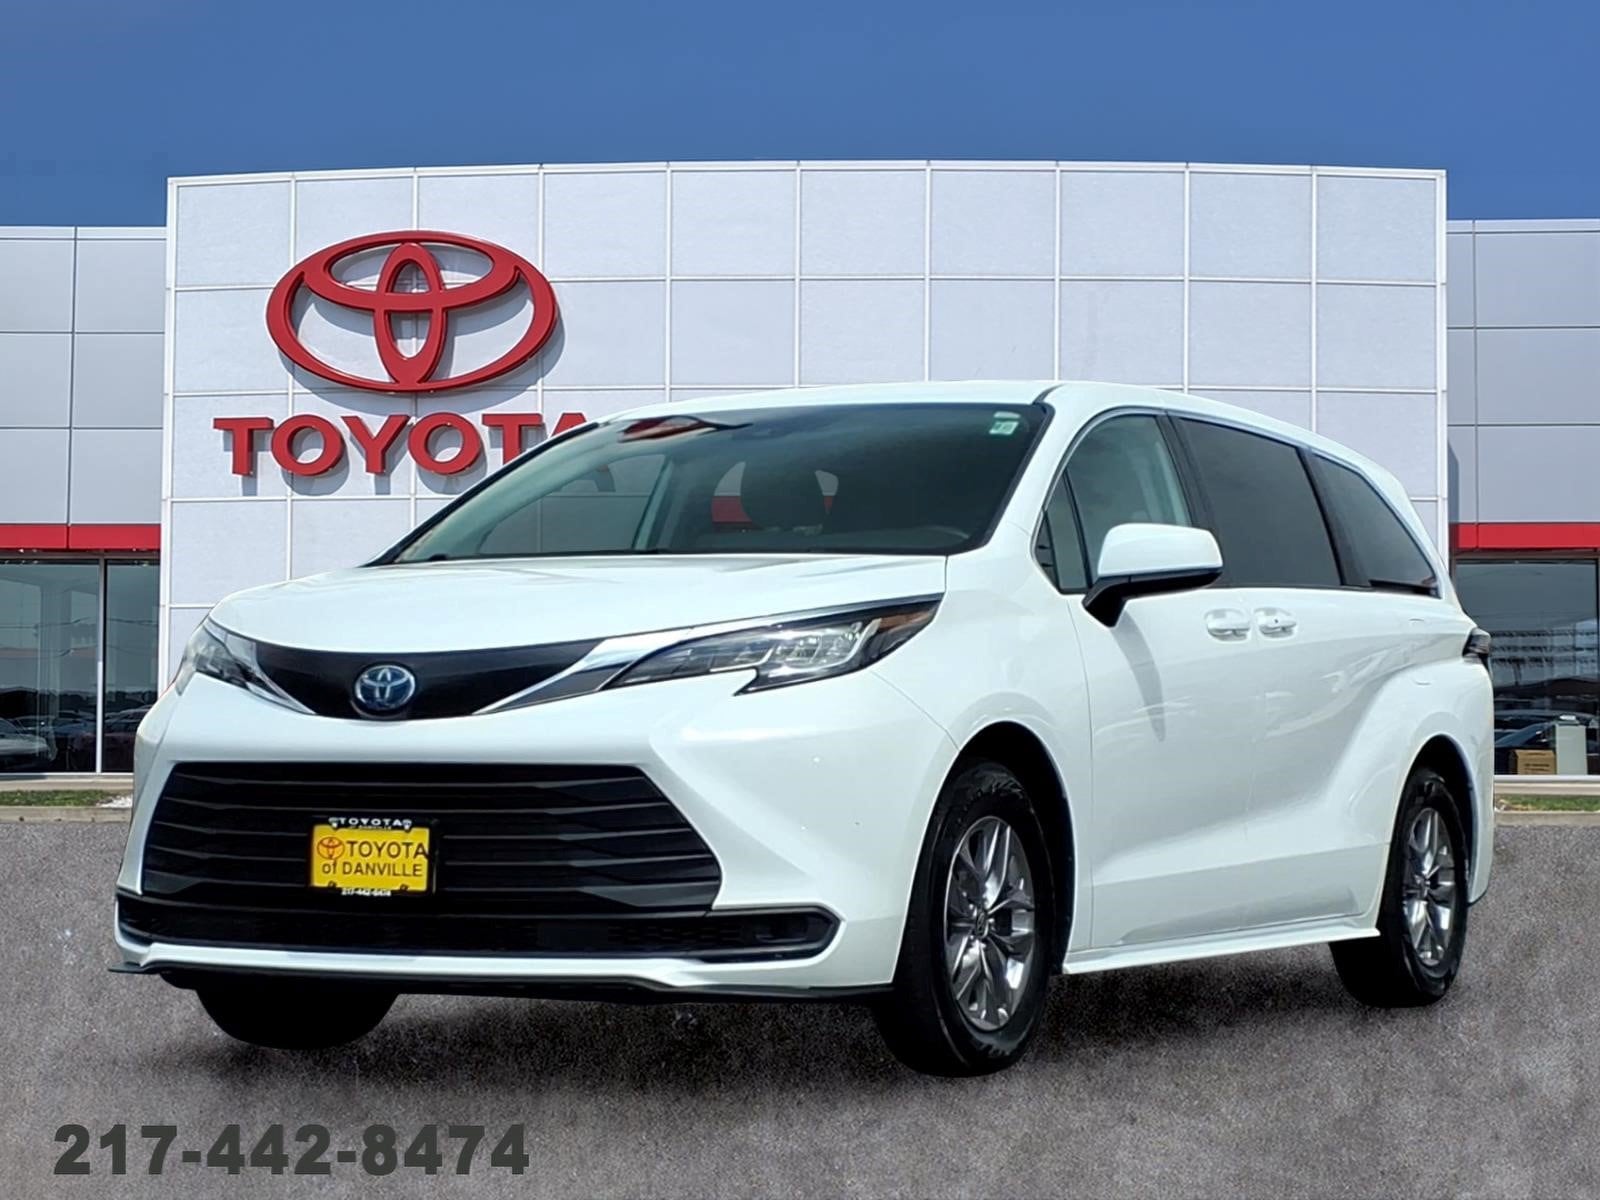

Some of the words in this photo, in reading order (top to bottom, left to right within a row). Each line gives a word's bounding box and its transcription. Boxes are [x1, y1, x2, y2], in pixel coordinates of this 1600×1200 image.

[339, 817, 402, 826] TOYOTA
[346, 840, 428, 860] TOYOTA
[321, 861, 337, 875] of
[342, 861, 423, 877] DANVILLE
